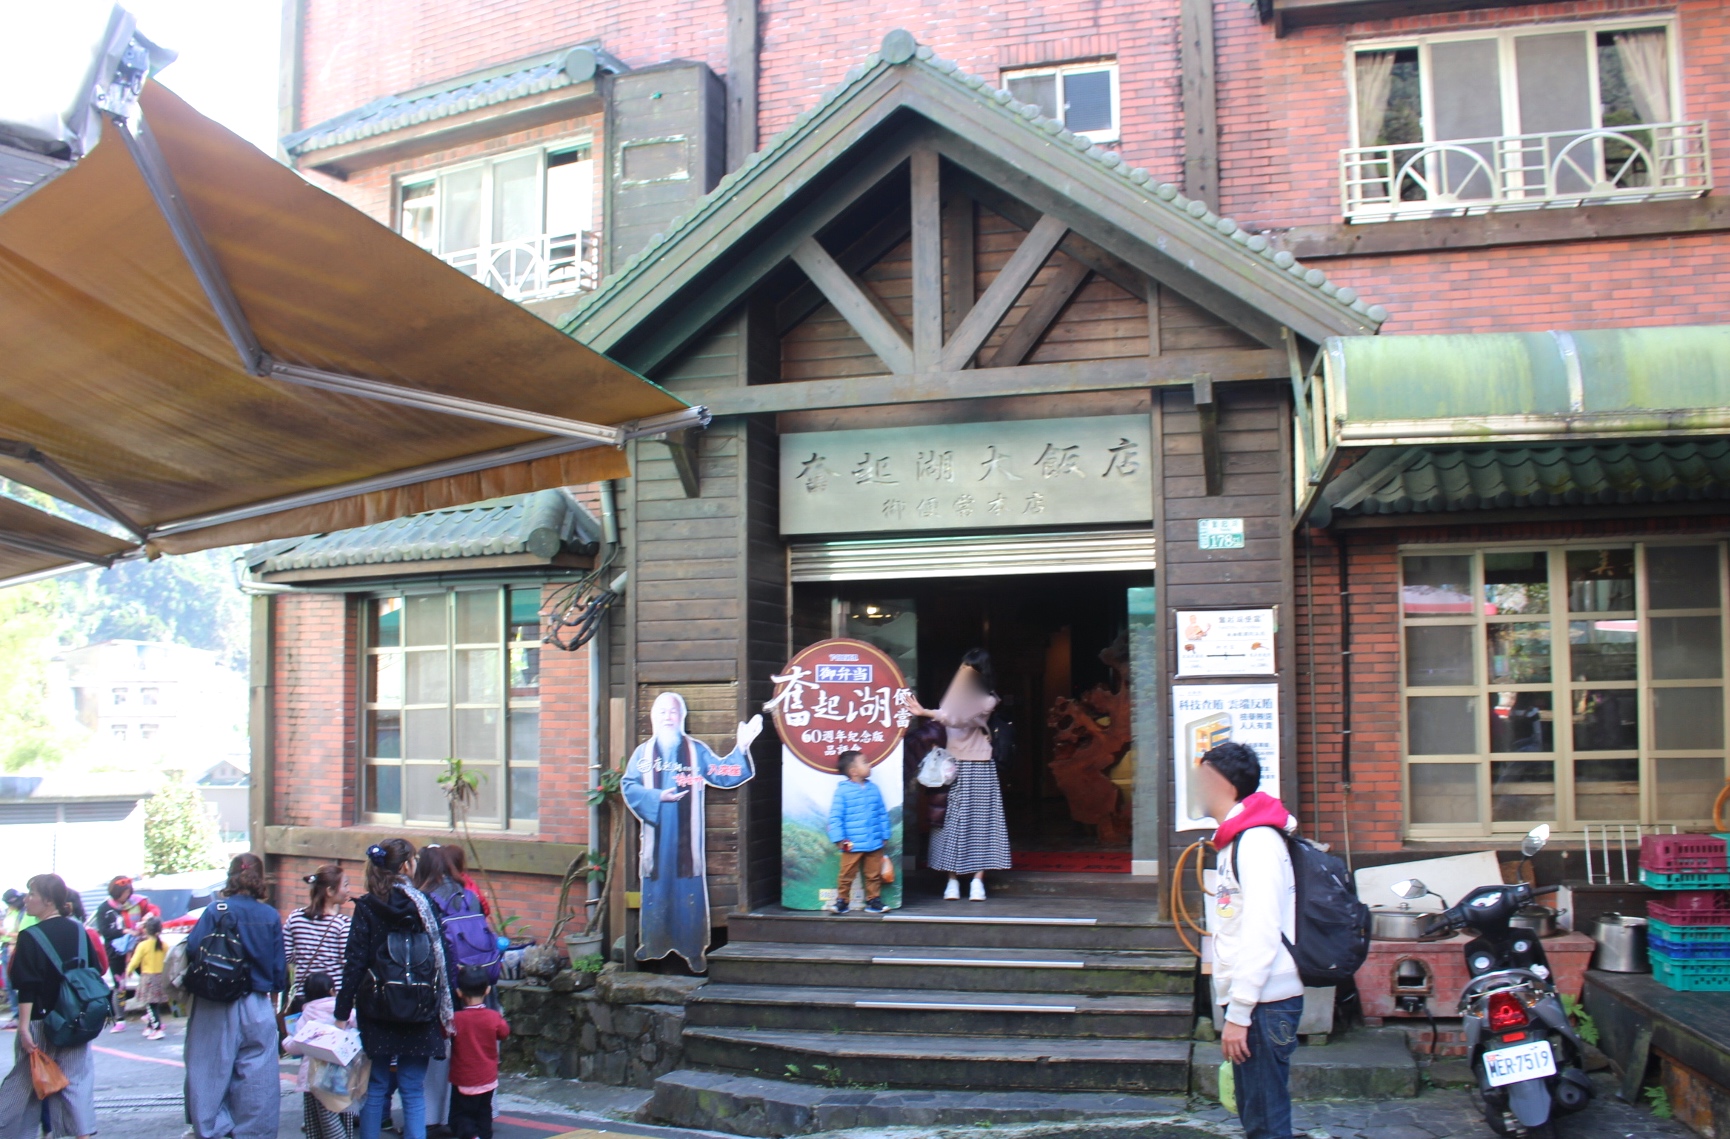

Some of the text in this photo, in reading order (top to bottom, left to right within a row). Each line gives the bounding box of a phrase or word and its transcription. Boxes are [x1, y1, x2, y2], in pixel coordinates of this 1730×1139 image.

[795, 438, 1141, 494] 奮起湖大飯店
[819, 666, 869, 681] 御弁当
[763, 666, 892, 728] 奮起湖
[1488, 1051, 1548, 1078] MER-7519
